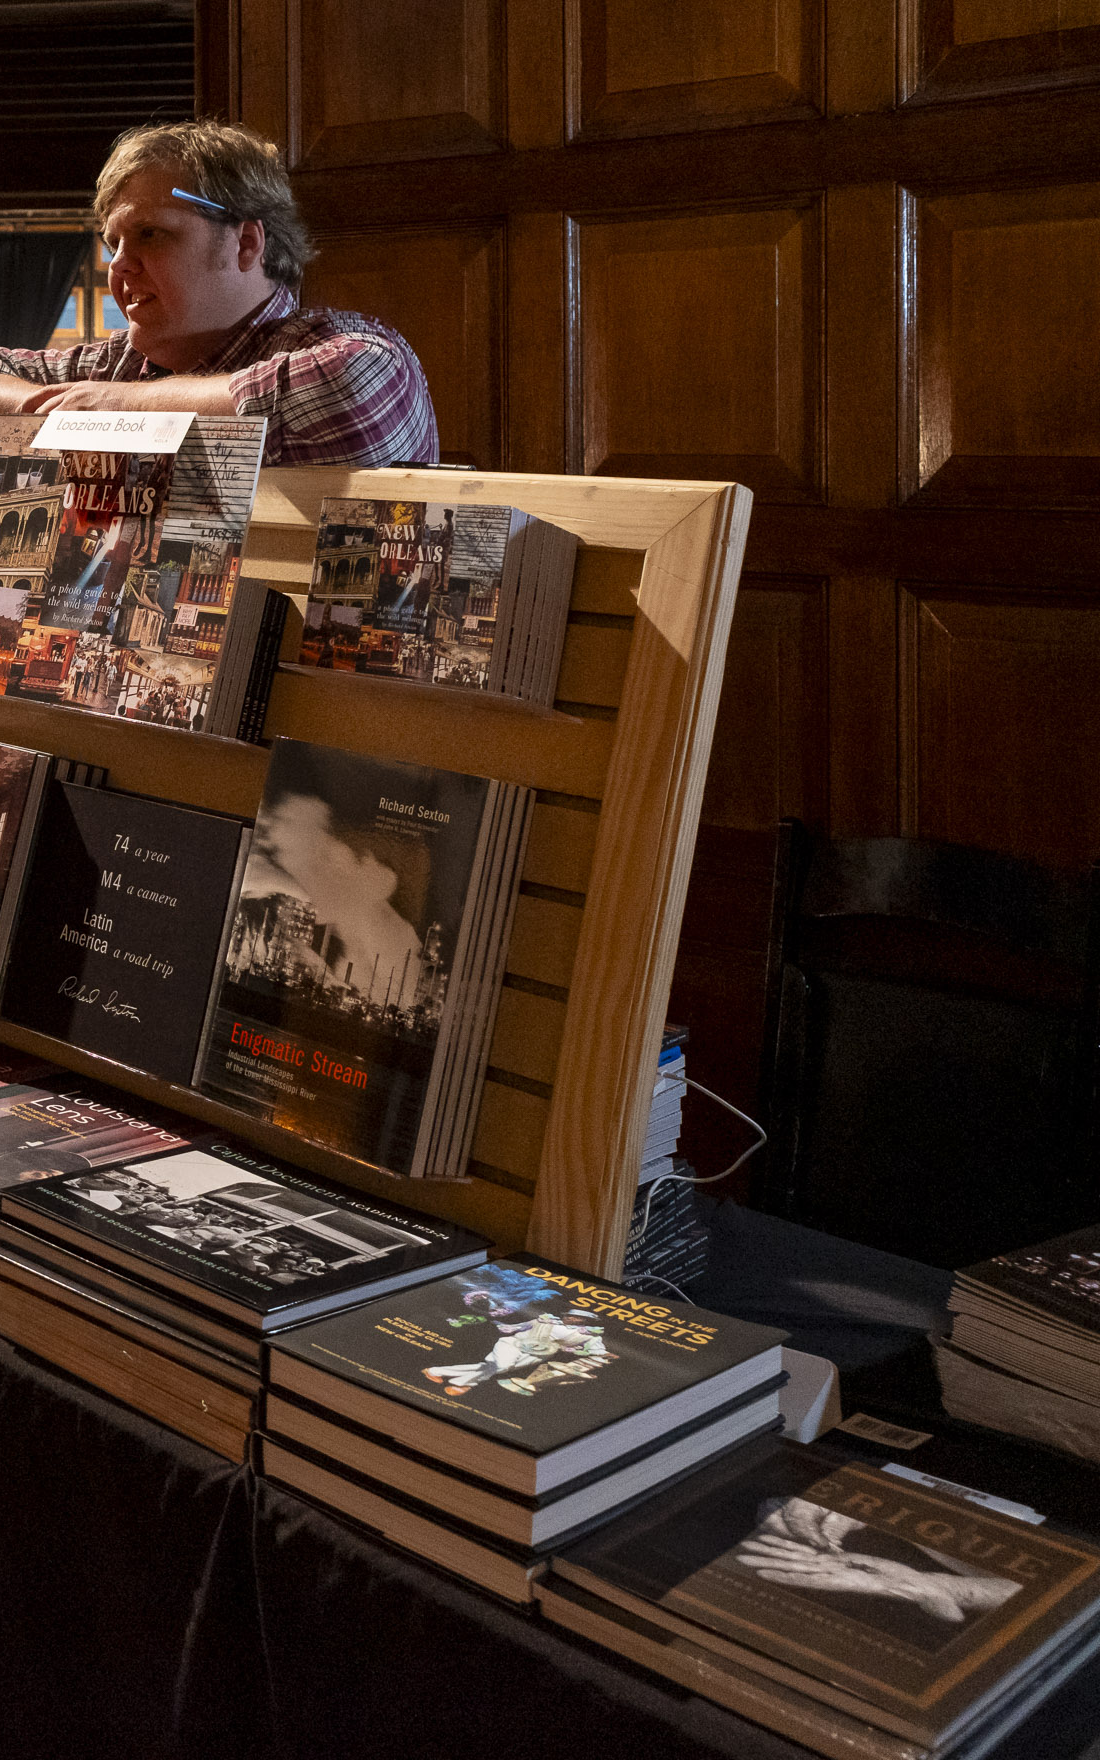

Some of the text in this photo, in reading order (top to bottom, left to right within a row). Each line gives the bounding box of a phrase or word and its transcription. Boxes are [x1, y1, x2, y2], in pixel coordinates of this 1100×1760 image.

[56, 417, 146, 432] Looziana Book
[62, 452, 126, 479] NEW
[62, 482, 157, 514] ORLEANS
[376, 523, 421, 541] NEW
[380, 542, 443, 563] ORLEANS
[47, 595, 60, 607] the
[63, 598, 81, 610] wild
[58, 583, 82, 596] photo
[84, 587, 108, 600] guide
[378, 796, 451, 824] Richard Sexton
[113, 833, 171, 865] 74 a year
[100, 869, 178, 908] M4 a camera
[83, 907, 113, 933] Latin
[59, 923, 175, 979] America a road trip
[227, 1049, 295, 1081] Industrial Landscapes
[230, 1021, 369, 1090] Enigmatic Stream
[225, 1062, 317, 1101] of the Lower Mississippi River
[30, 1096, 95, 1125] Lens
[58, 1090, 182, 1143] Louisiana
[210, 1144, 258, 1167] Cajun
[256, 1163, 347, 1202] Document
[35, 1186, 96, 1214] PHOTOGRAPHS
[94, 1213, 109, 1221] BY
[107, 1219, 149, 1239] DOUGLAS
[166, 1245, 187, 1256] AND
[187, 1254, 231, 1273] CHARLES
[240, 1275, 273, 1292] TRAUB
[523, 1266, 720, 1335] DANCING IN THE
[382, 1317, 453, 1349] PLEASURE CLUBS
[393, 1316, 423, 1332] SOCIAL
[568, 1296, 715, 1346] STREETS
[374, 1324, 435, 1352] NEW ORLEANS
[659, 1338, 699, 1353] COOPER
